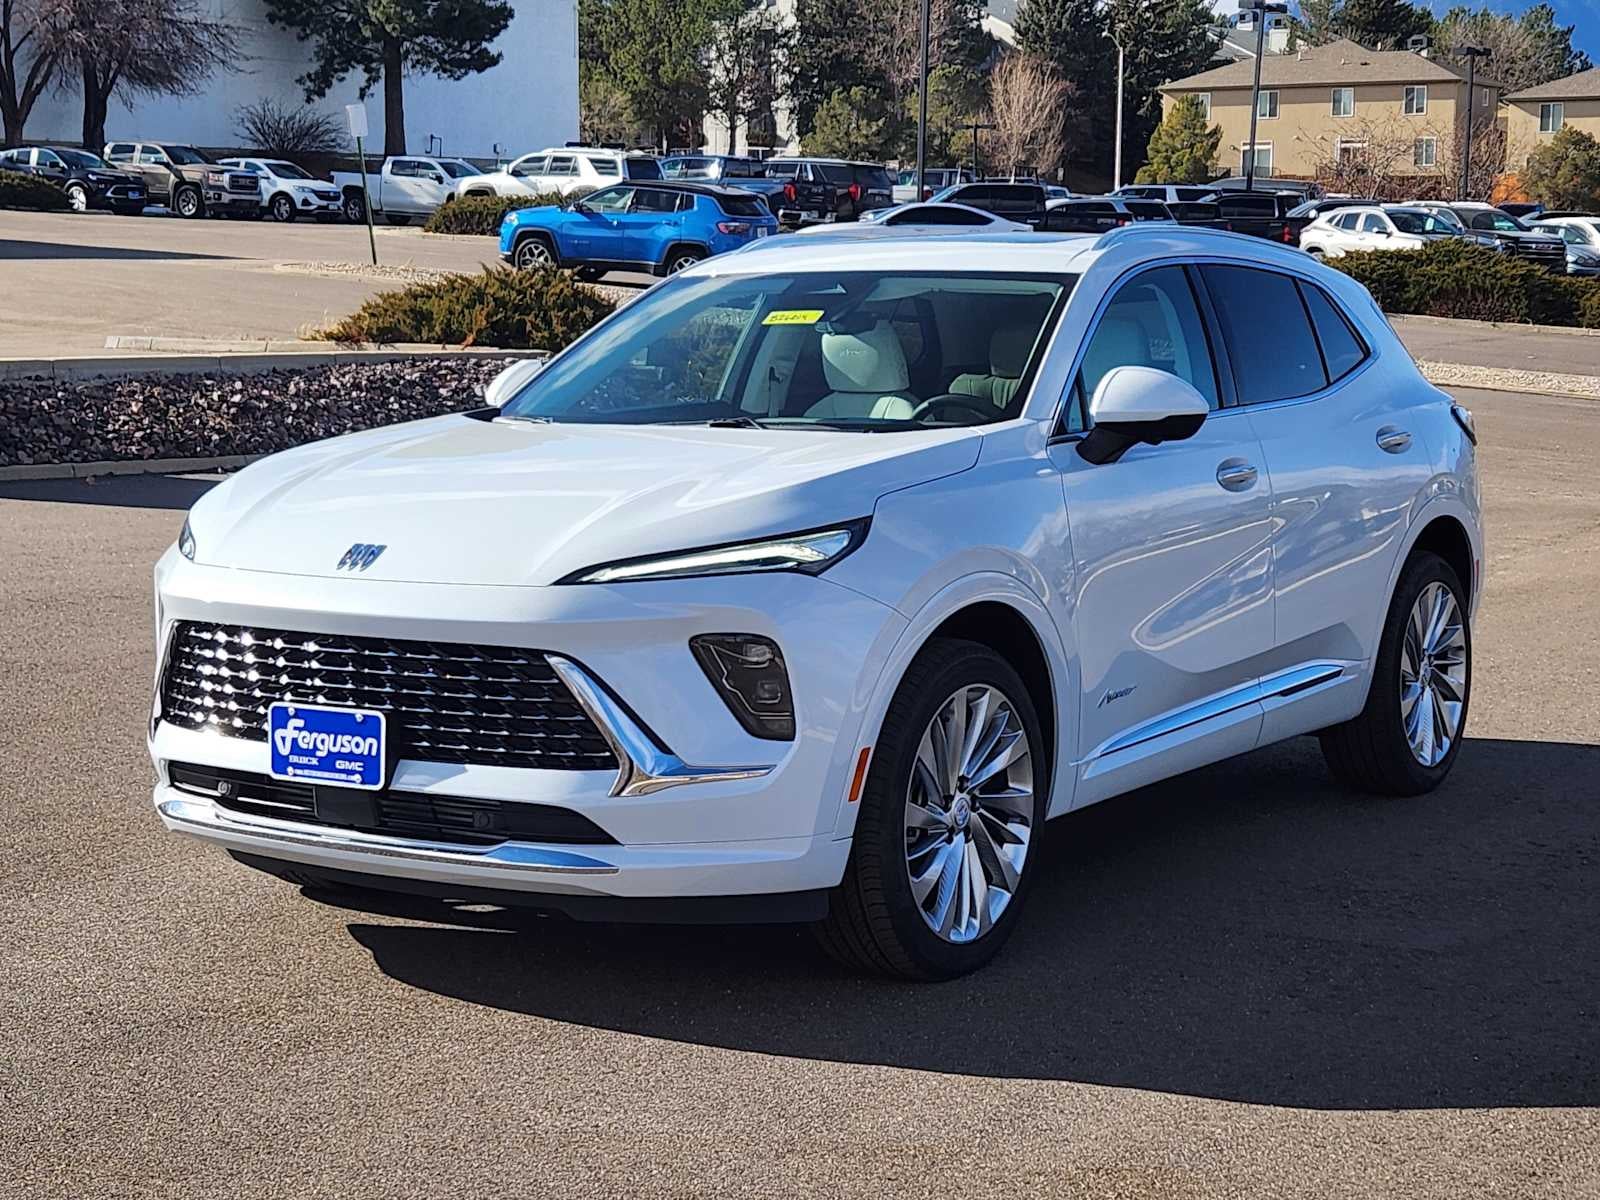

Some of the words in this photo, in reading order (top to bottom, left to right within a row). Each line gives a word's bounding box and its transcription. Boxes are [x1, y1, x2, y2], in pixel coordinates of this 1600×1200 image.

[274, 718, 378, 757] Ferguson
[288, 755, 319, 766] BUICK
[335, 760, 364, 772] GMC
